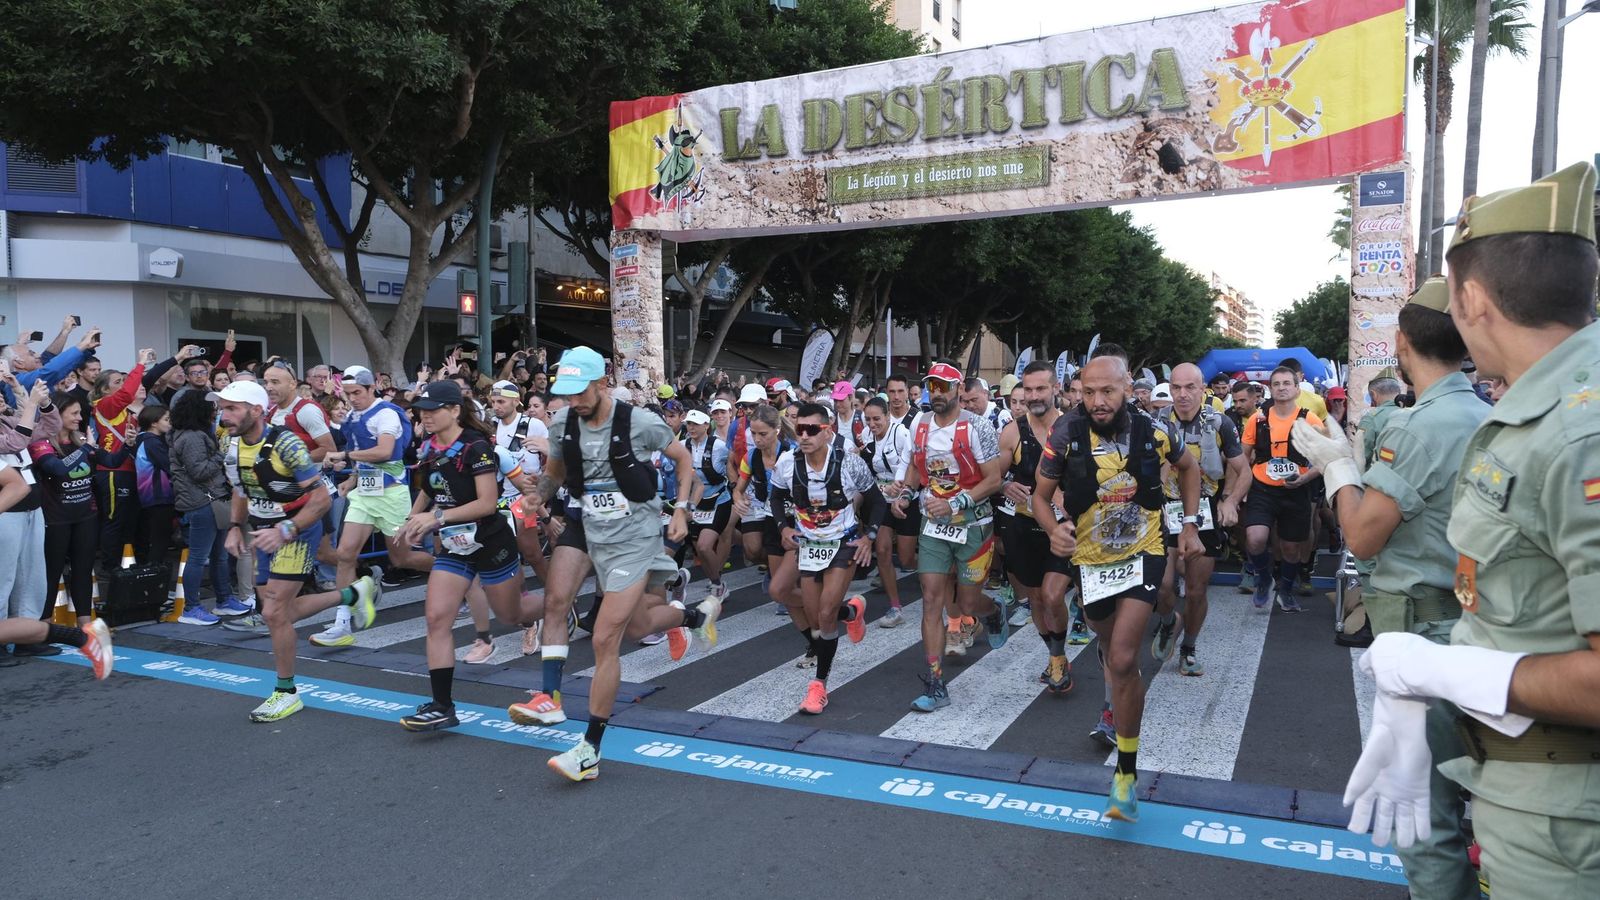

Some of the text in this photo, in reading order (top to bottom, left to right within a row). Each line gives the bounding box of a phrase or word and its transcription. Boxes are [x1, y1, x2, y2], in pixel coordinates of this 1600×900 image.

[719, 48, 1191, 161] LA DESÉRTICA
[848, 162, 1024, 190] La Legión y el desierto nos une
[1360, 242, 1401, 250] GRUPO
[1360, 250, 1402, 261] RENTA
[1360, 260, 1402, 273] TODO
[567, 289, 608, 303] AUTOMO
[1356, 356, 1397, 367] primaflo
[1273, 463, 1295, 473] 3816
[361, 477, 376, 487] 230
[592, 493, 616, 508] 805
[934, 524, 962, 539] 5497
[808, 548, 834, 560] 5498
[1099, 564, 1134, 584] 5422
[174, 664, 261, 684] cajamar
[310, 690, 414, 711] cajamar
[480, 719, 586, 741] cajama
[687, 752, 833, 780] cajamar
[746, 770, 817, 785] CAJA RURAL
[1023, 811, 1113, 830] CAJA RURAL
[1369, 863, 1403, 873] CAJ
